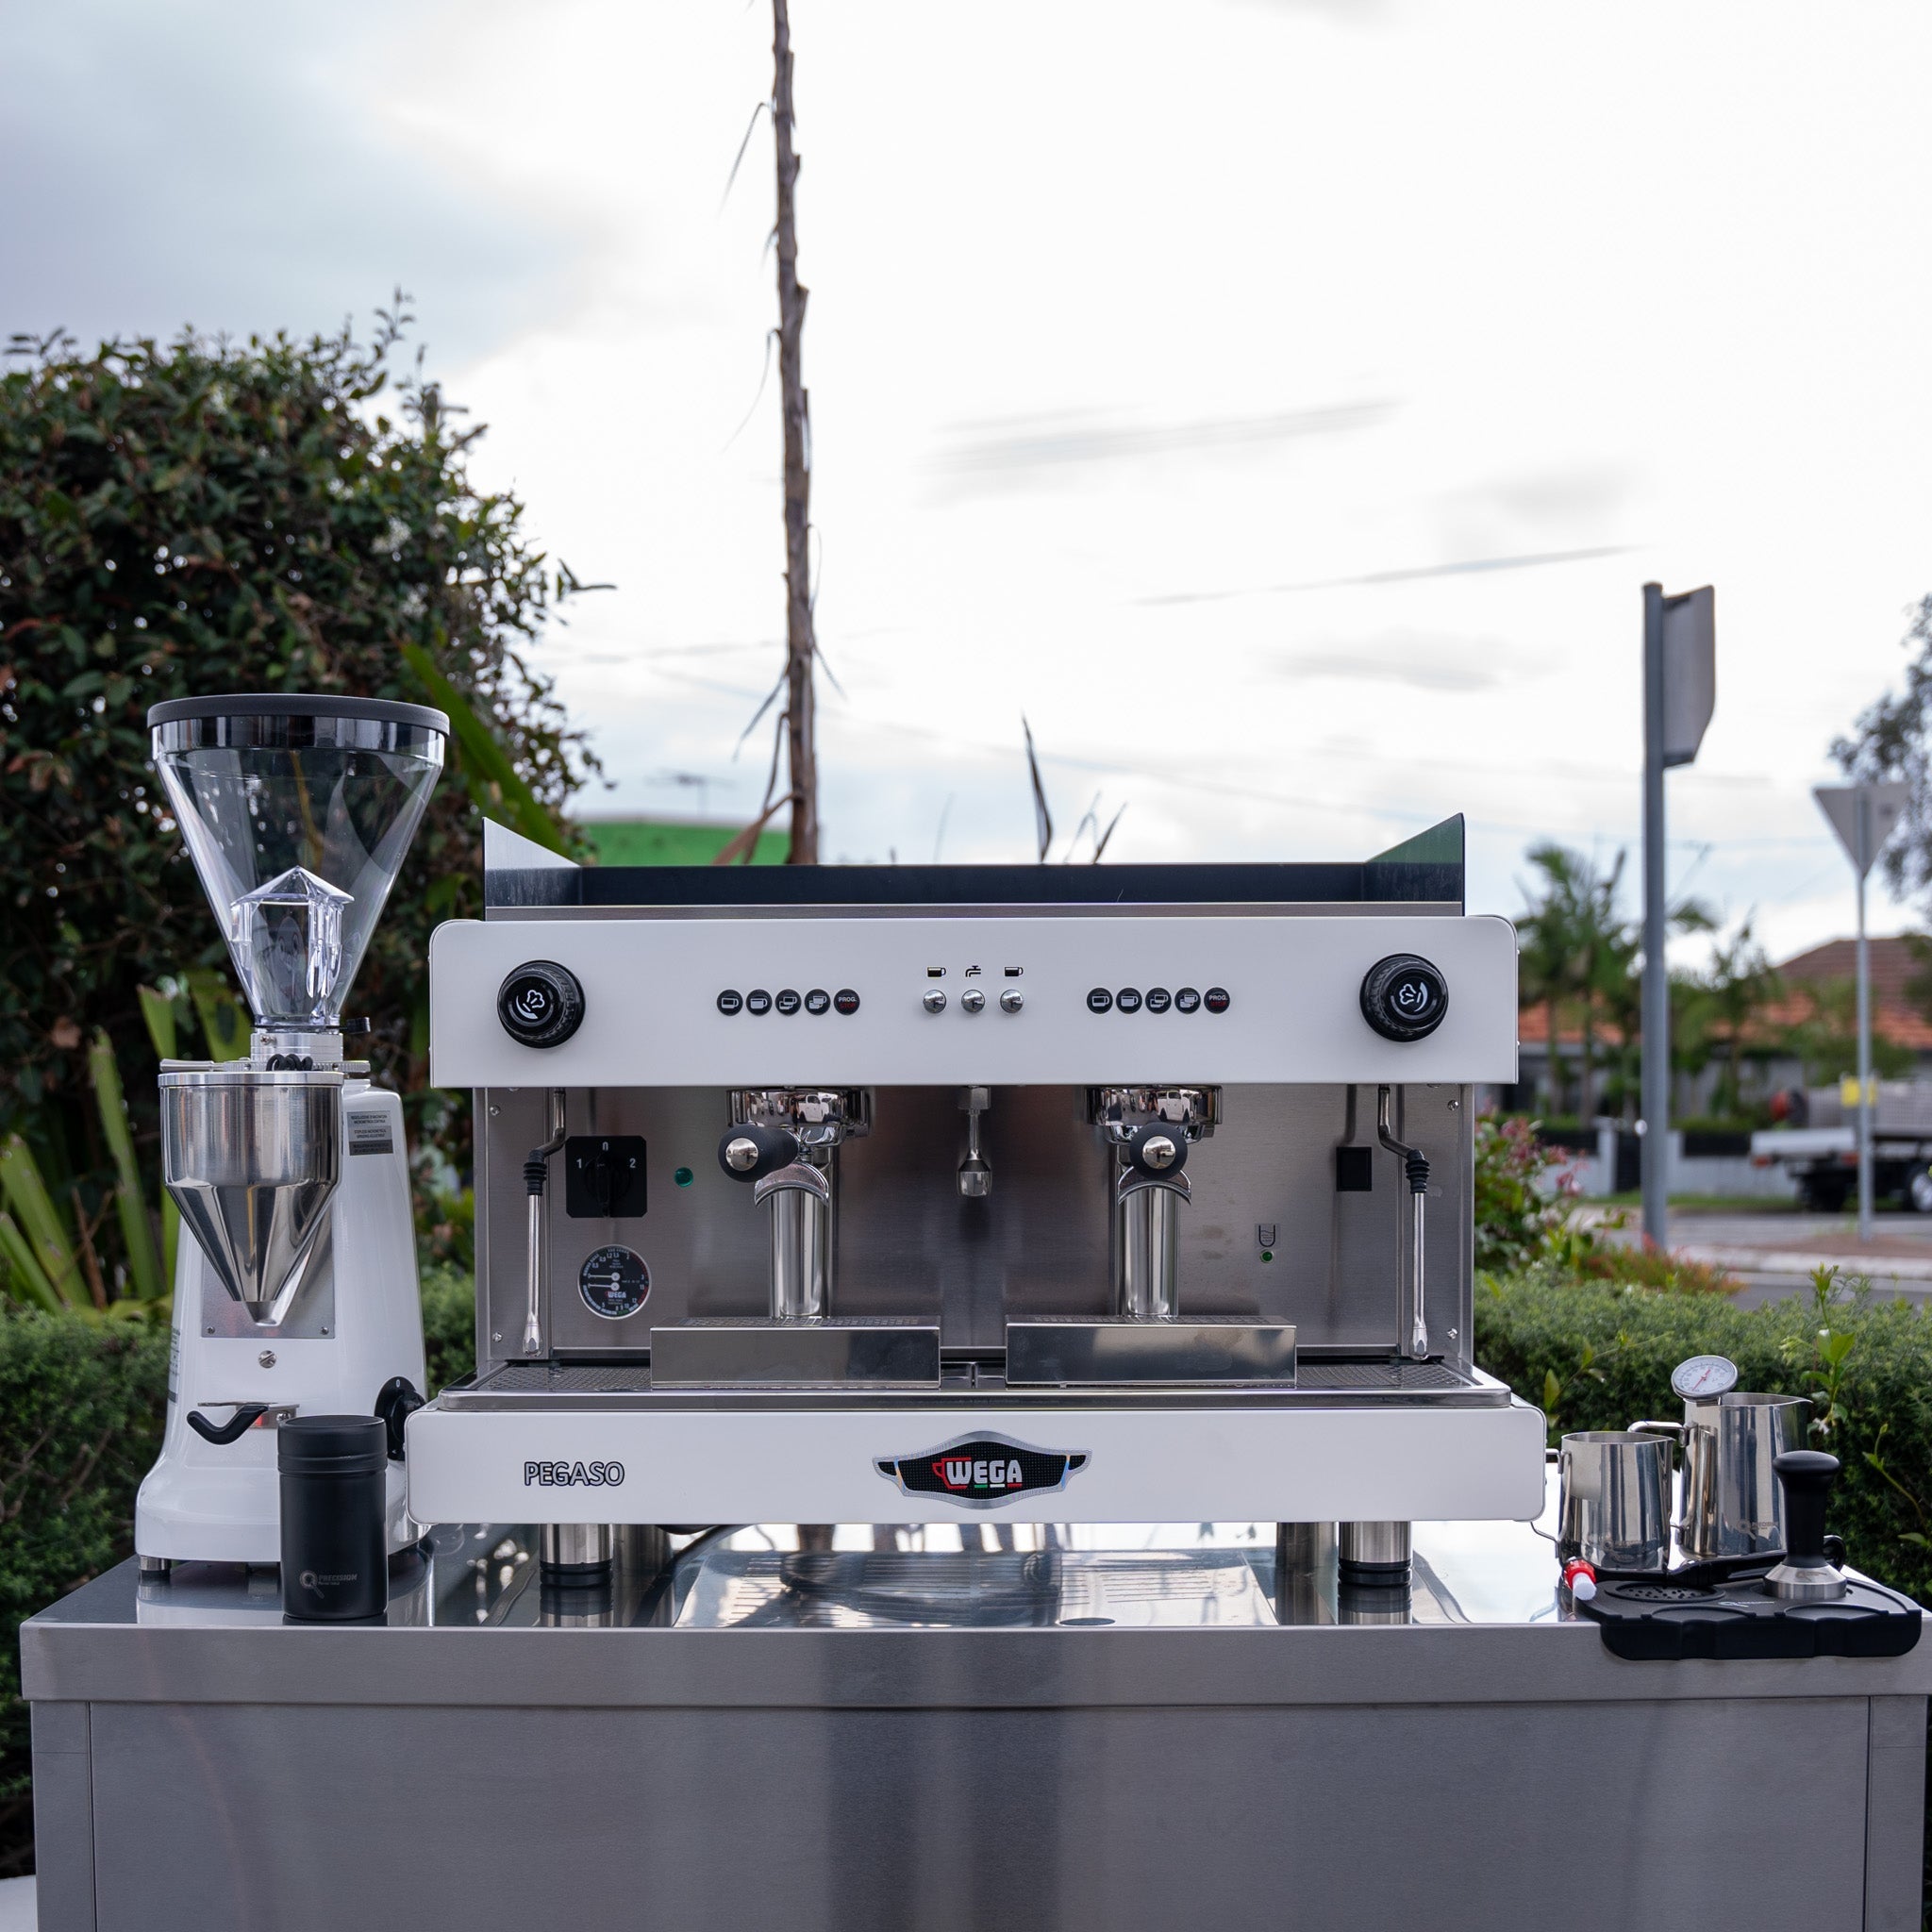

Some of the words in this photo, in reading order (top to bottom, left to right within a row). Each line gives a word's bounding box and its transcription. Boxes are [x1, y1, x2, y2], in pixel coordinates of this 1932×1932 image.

[576, 1158, 582, 1169] 1
[629, 1158, 636, 1169] 2
[524, 1461, 625, 1487] PEGASO
[946, 1459, 1023, 1485] WEGA
[318, 1574, 358, 1583] PRECISION
